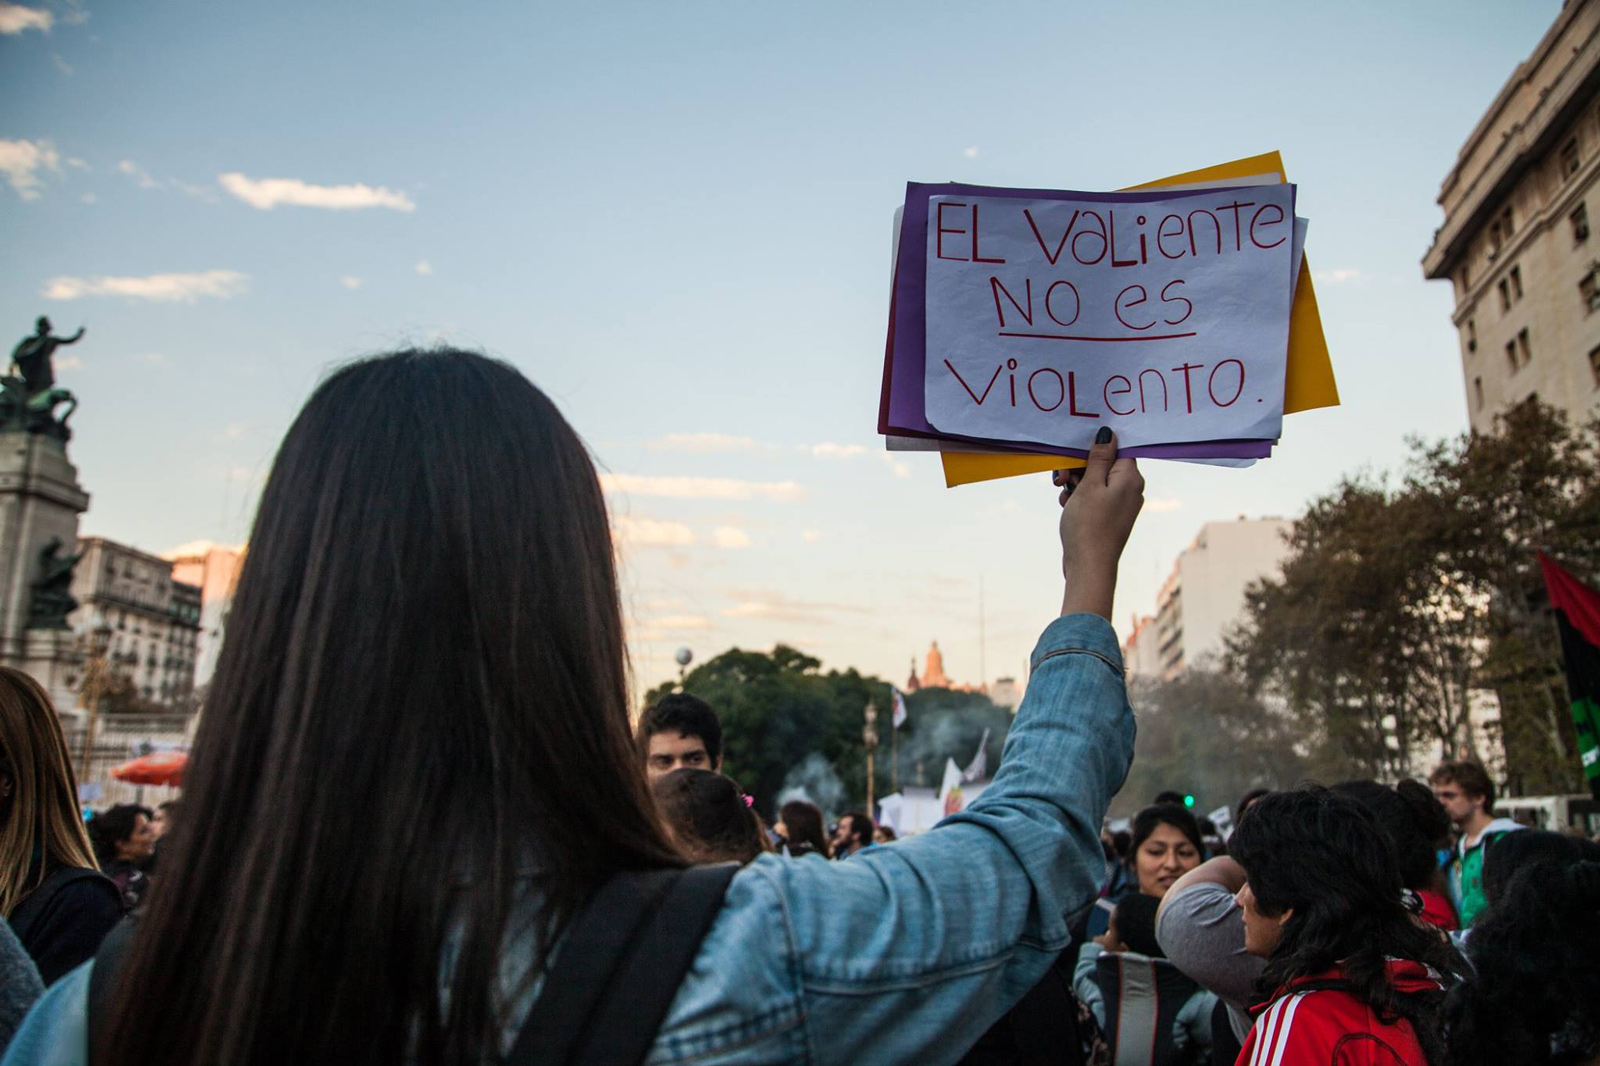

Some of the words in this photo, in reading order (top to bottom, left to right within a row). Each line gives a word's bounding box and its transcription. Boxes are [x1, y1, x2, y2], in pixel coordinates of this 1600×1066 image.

[937, 202, 1006, 264] EL
[989, 276, 1081, 328] NO
[1114, 279, 1193, 330] es
